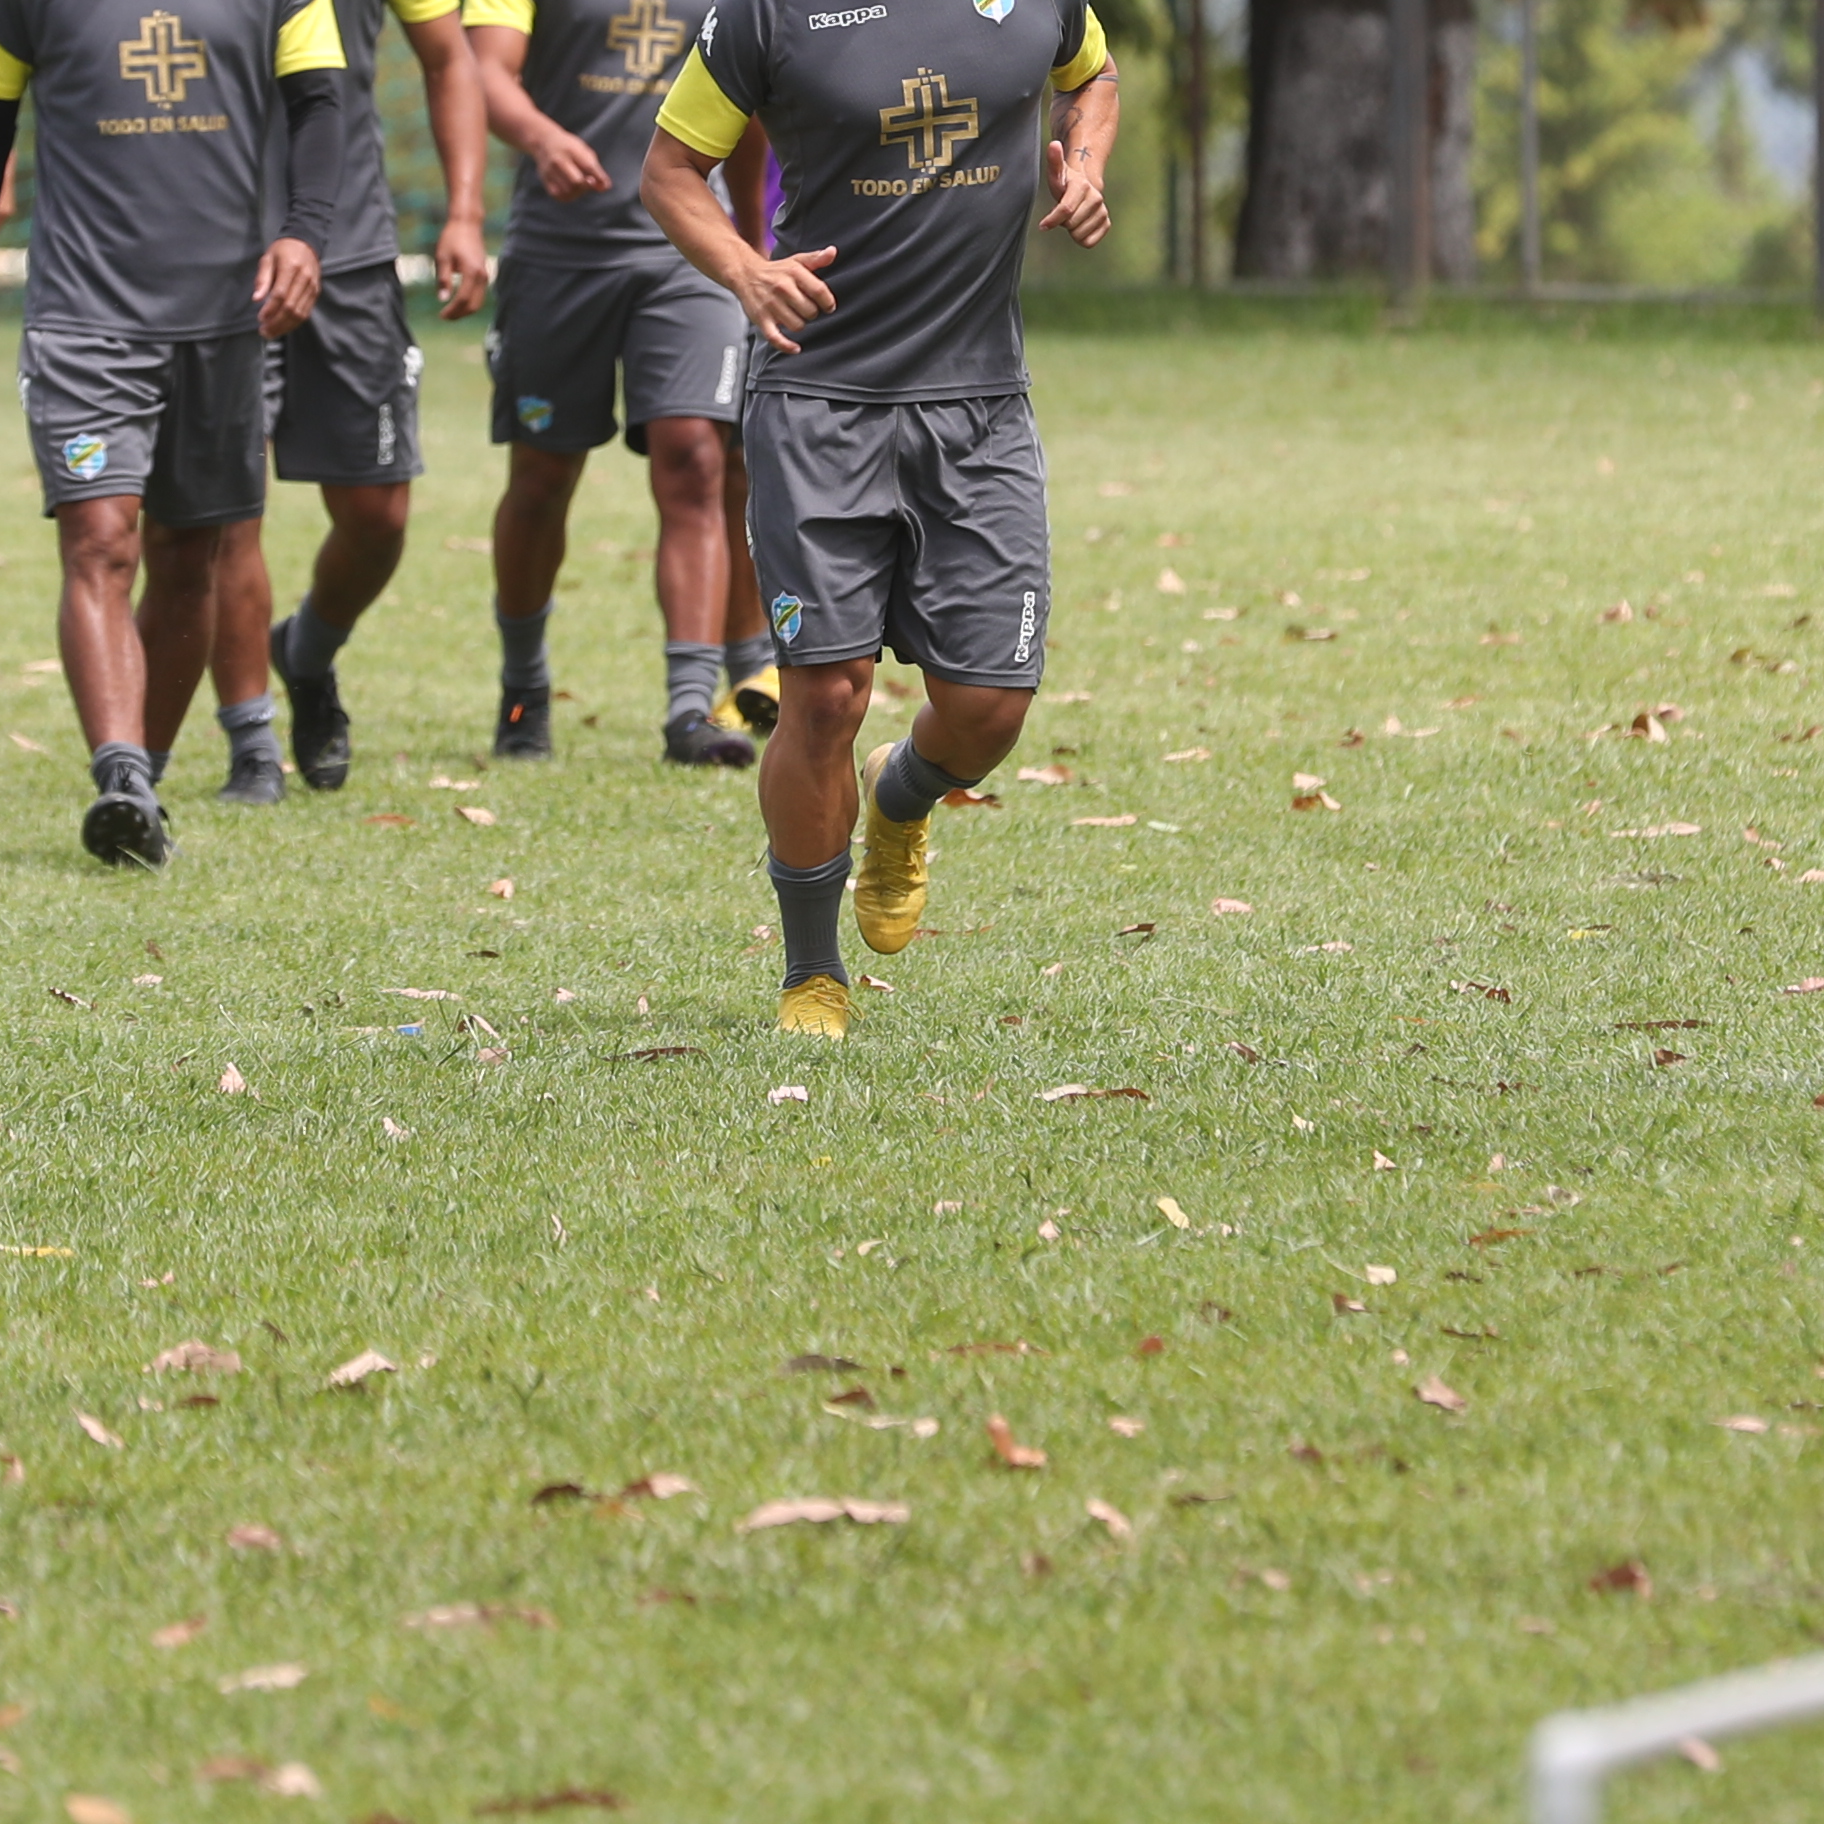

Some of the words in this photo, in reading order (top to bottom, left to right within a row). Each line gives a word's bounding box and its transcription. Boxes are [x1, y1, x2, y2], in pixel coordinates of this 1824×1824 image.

[808, 4, 888, 31] Kappa
[850, 178, 908, 197] TODO
[911, 177, 937, 195] EN
[939, 165, 1001, 189] SALUD
[1015, 591, 1036, 663] Kappa
